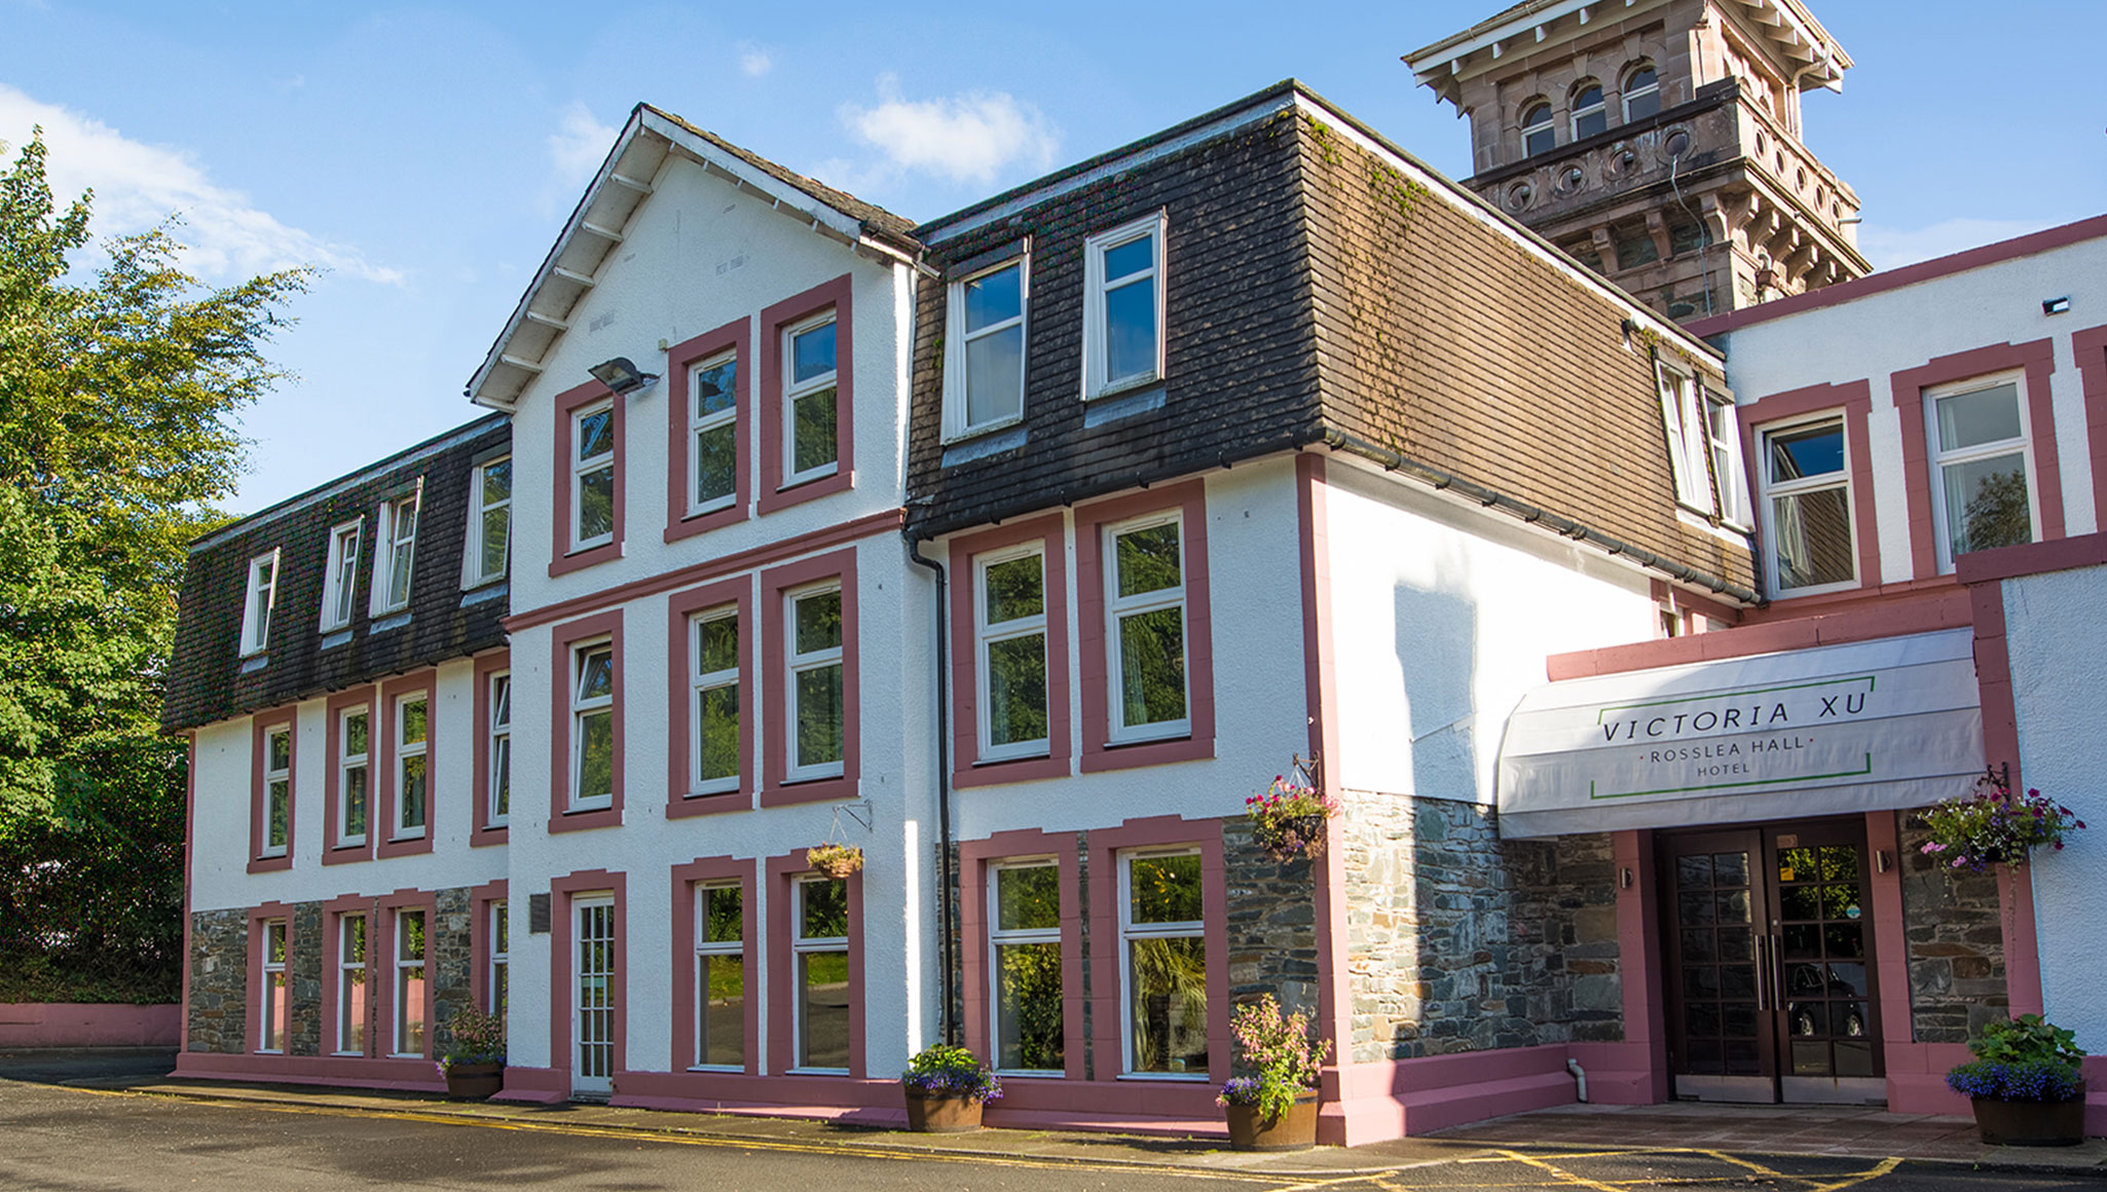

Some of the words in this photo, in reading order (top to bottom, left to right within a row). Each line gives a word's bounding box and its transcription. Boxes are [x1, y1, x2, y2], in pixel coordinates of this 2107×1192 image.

[1604, 703, 1788, 741] VICTORIA
[1819, 693, 1865, 717] XU
[1651, 743, 1740, 763] ROSSLEA
[1752, 737, 1804, 752] HALL
[1697, 763, 1750, 777] HOTEL
